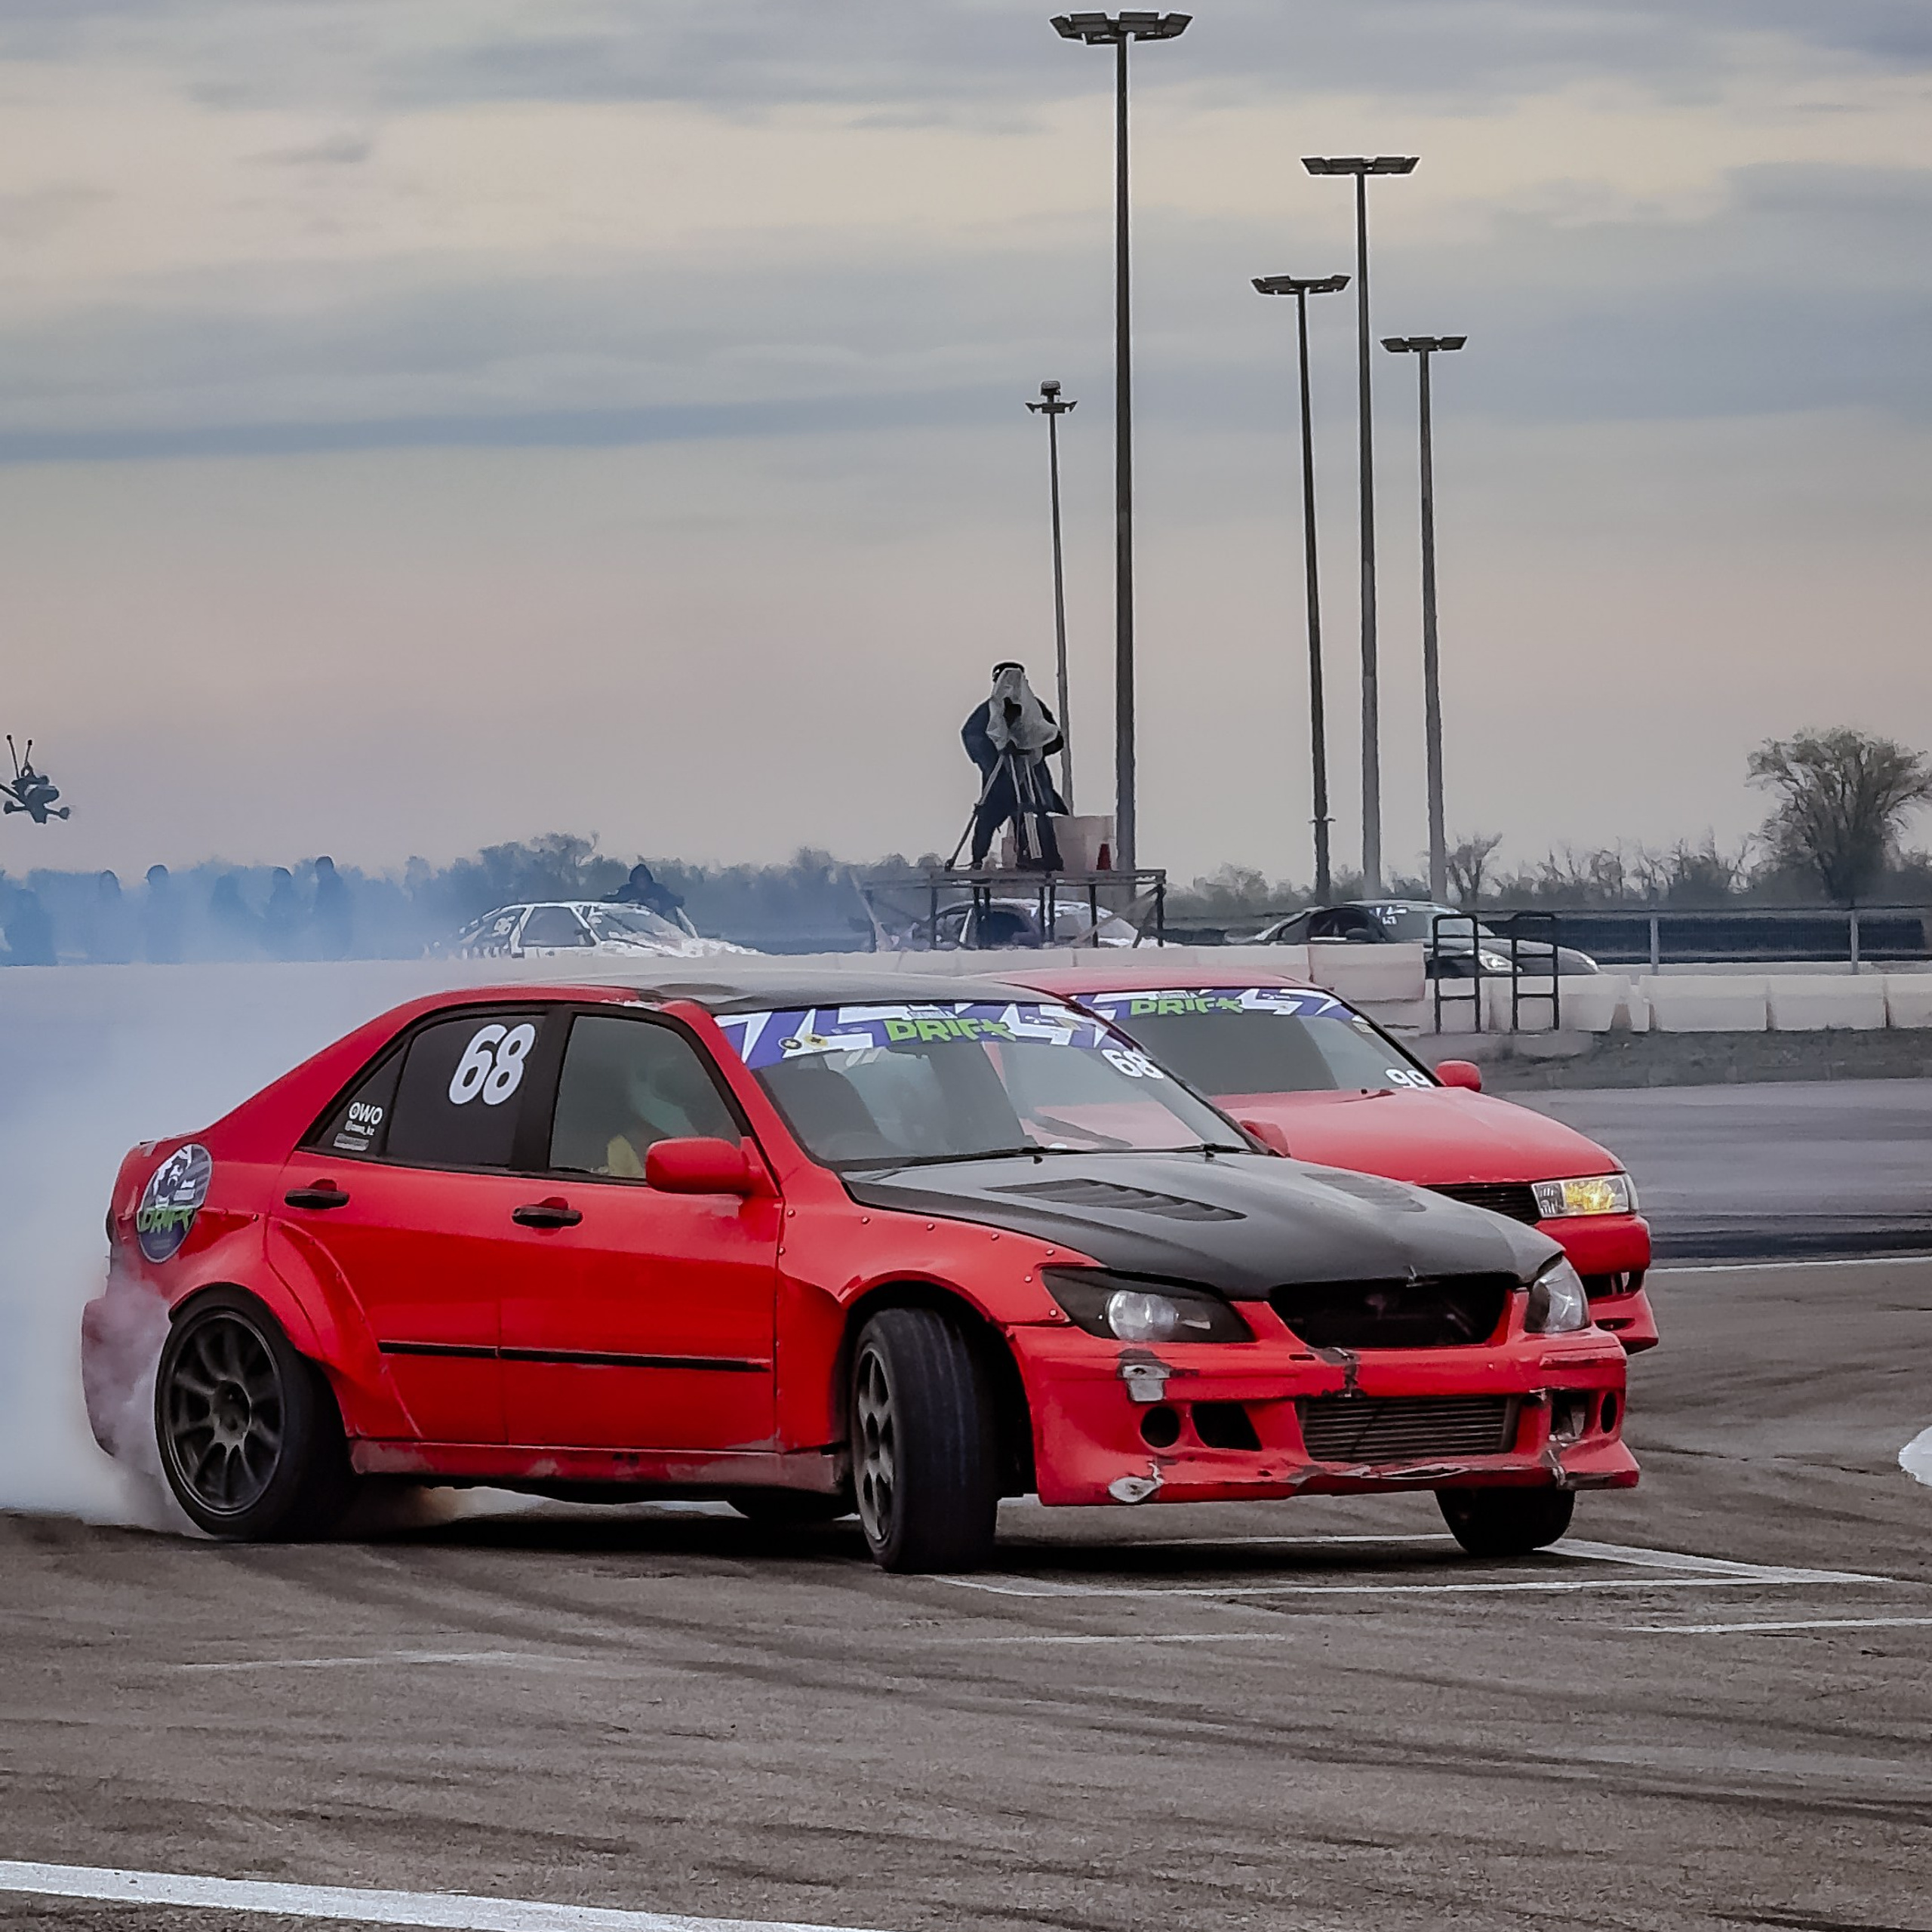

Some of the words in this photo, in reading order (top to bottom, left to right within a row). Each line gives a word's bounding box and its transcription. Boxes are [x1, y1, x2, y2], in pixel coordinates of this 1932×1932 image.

[1131, 997, 1244, 1016] DRIFT
[883, 1019, 1017, 1042] DRIFT
[448, 1023, 536, 1105] 68
[1101, 1049, 1164, 1079] 68
[1386, 1069, 1435, 1091] 99
